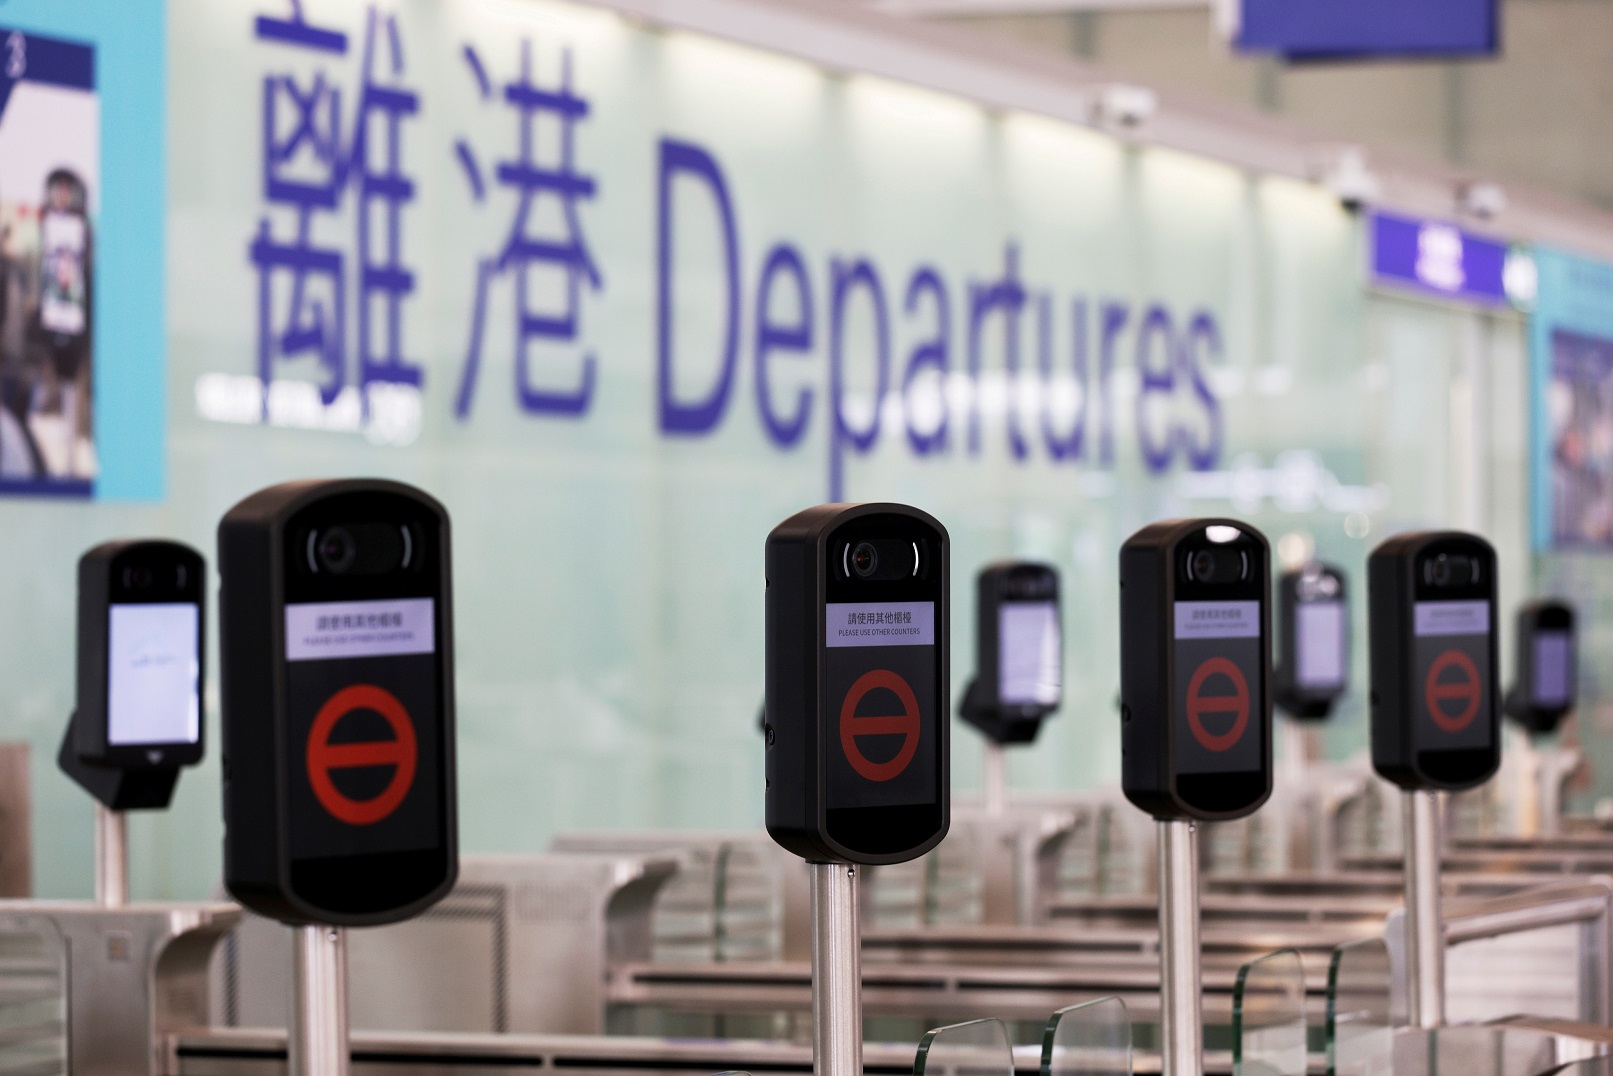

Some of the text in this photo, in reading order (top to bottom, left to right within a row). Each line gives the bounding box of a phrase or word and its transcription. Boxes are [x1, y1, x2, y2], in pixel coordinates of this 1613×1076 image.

[248, 0, 1224, 503] 離港 Departures
[848, 612, 912, 625] 請使用其他櫃檯
[838, 629, 859, 637] PLEASE
[872, 628, 891, 636] OTHER
[891, 627, 920, 635] COUNTERS
